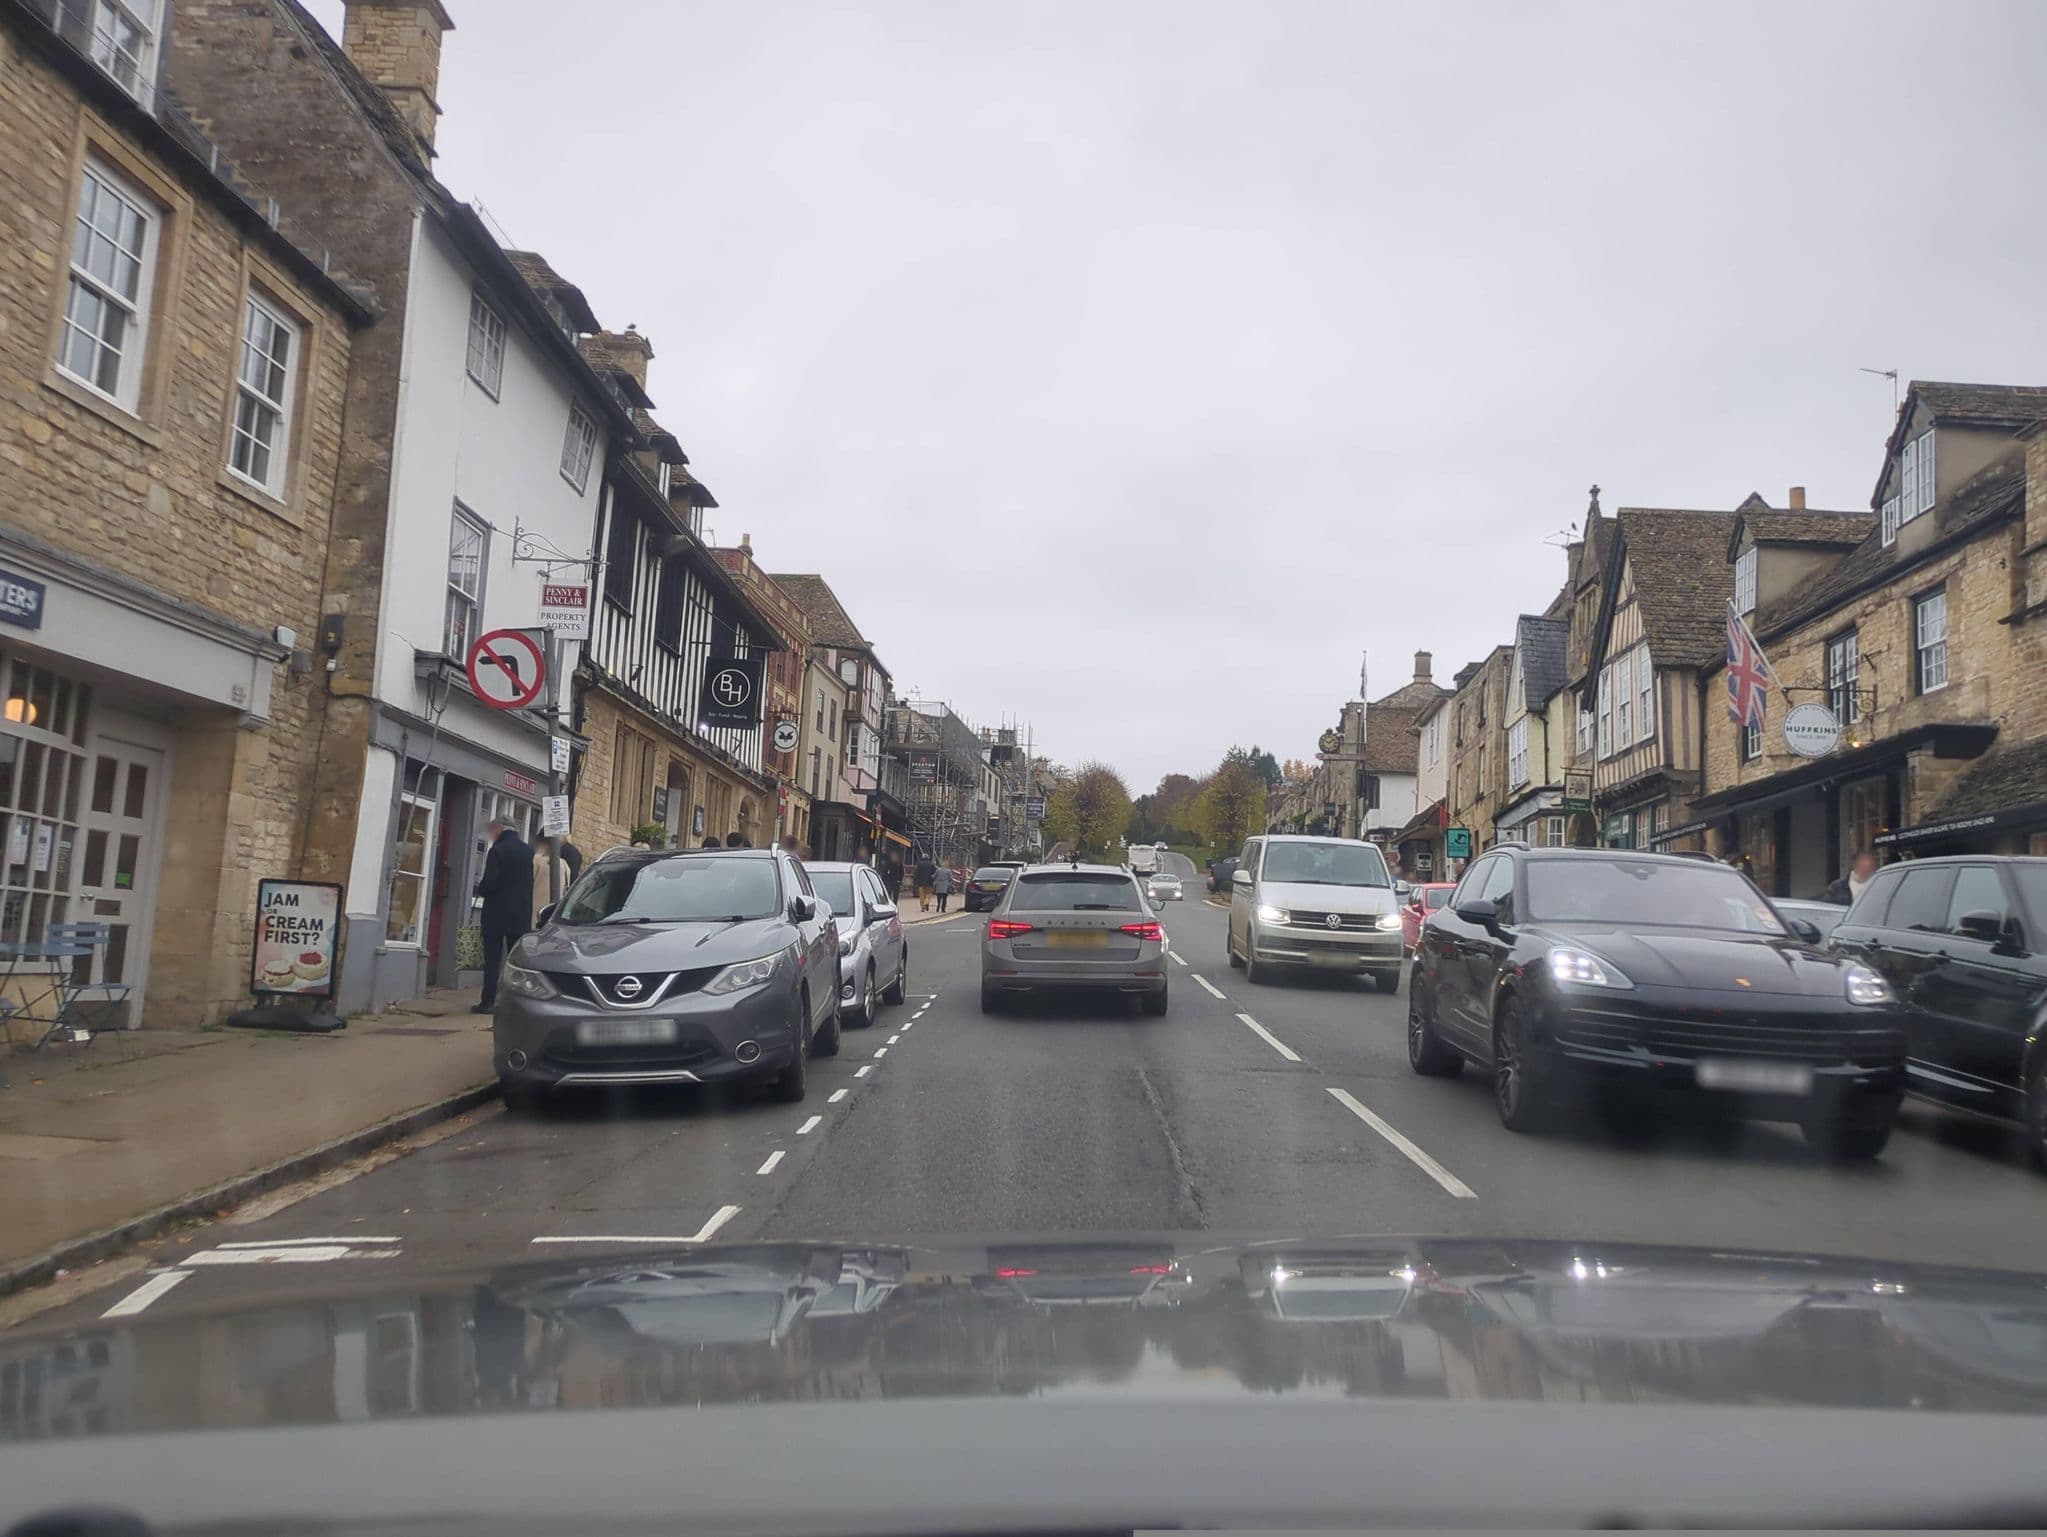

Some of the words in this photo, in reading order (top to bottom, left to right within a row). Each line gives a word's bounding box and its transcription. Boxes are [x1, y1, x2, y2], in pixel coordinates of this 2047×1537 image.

[545, 588, 571, 597] PENNY
[574, 589, 581, 597] &
[545, 596, 583, 605] SINCLAIR
[541, 612, 586, 621] PROPERTY
[544, 622, 581, 631] AGENTS
[264, 893, 299, 908] JAM
[265, 915, 324, 931] CREAM
[264, 930, 320, 946] FIRST?
